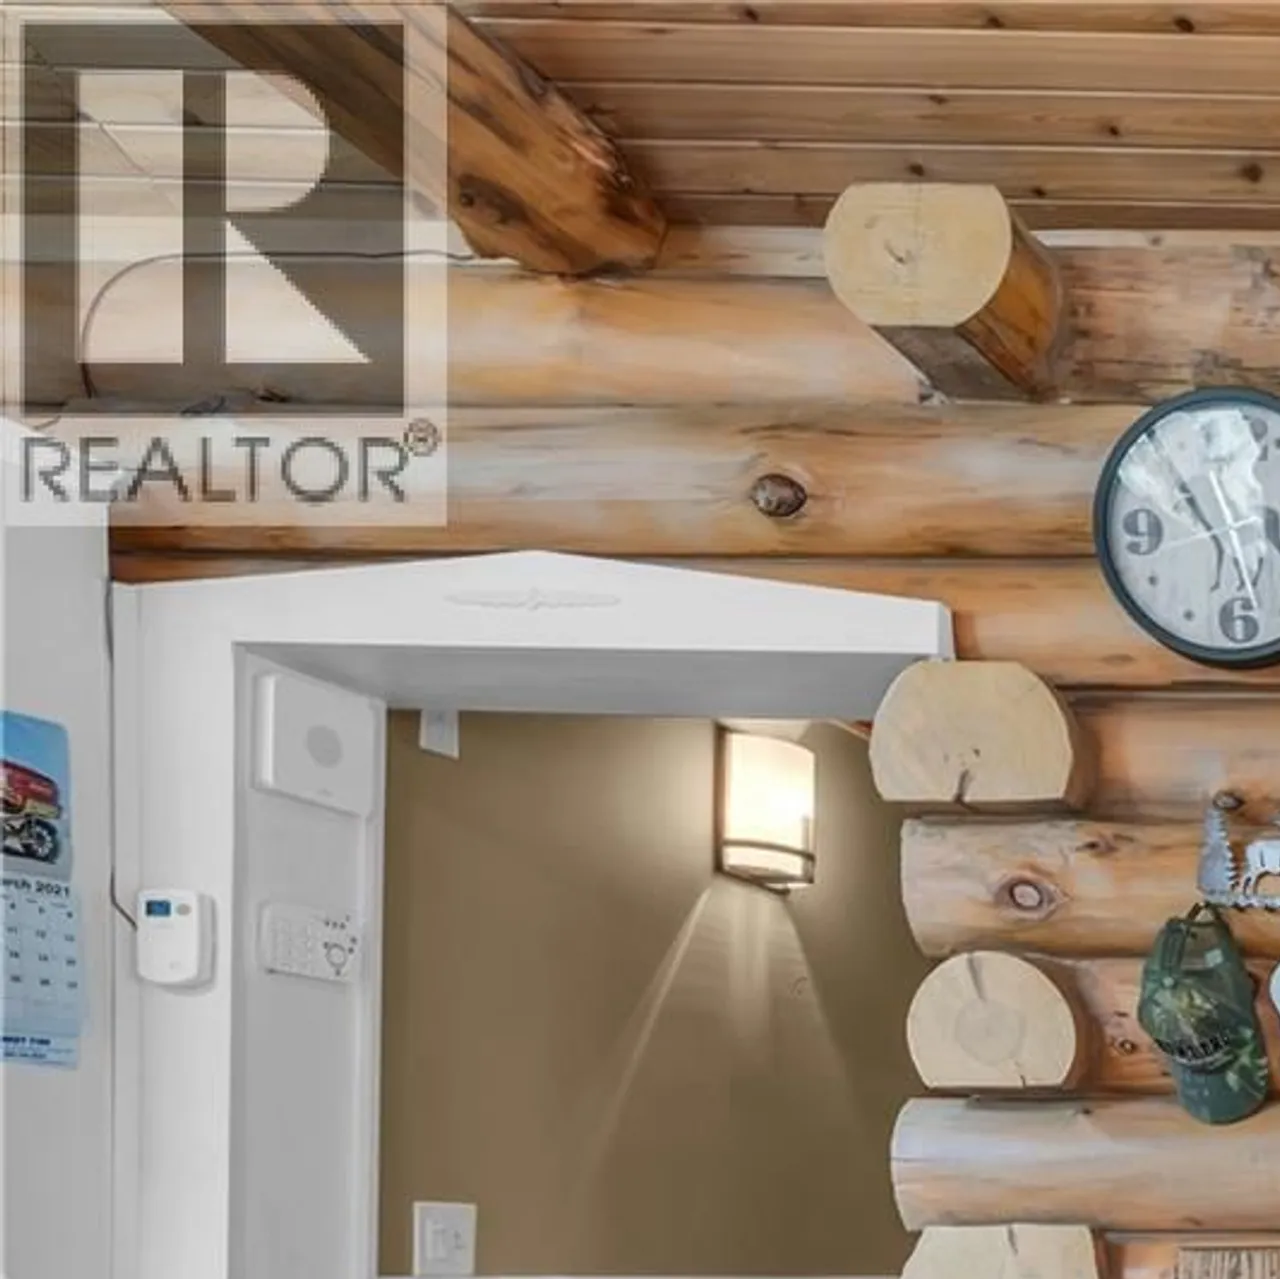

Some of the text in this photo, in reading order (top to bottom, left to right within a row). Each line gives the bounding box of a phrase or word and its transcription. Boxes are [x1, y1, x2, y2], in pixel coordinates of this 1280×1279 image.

[1122, 508, 1163, 556] 9
[1218, 597, 1260, 643] 6
[35, 880, 71, 898] 2021
